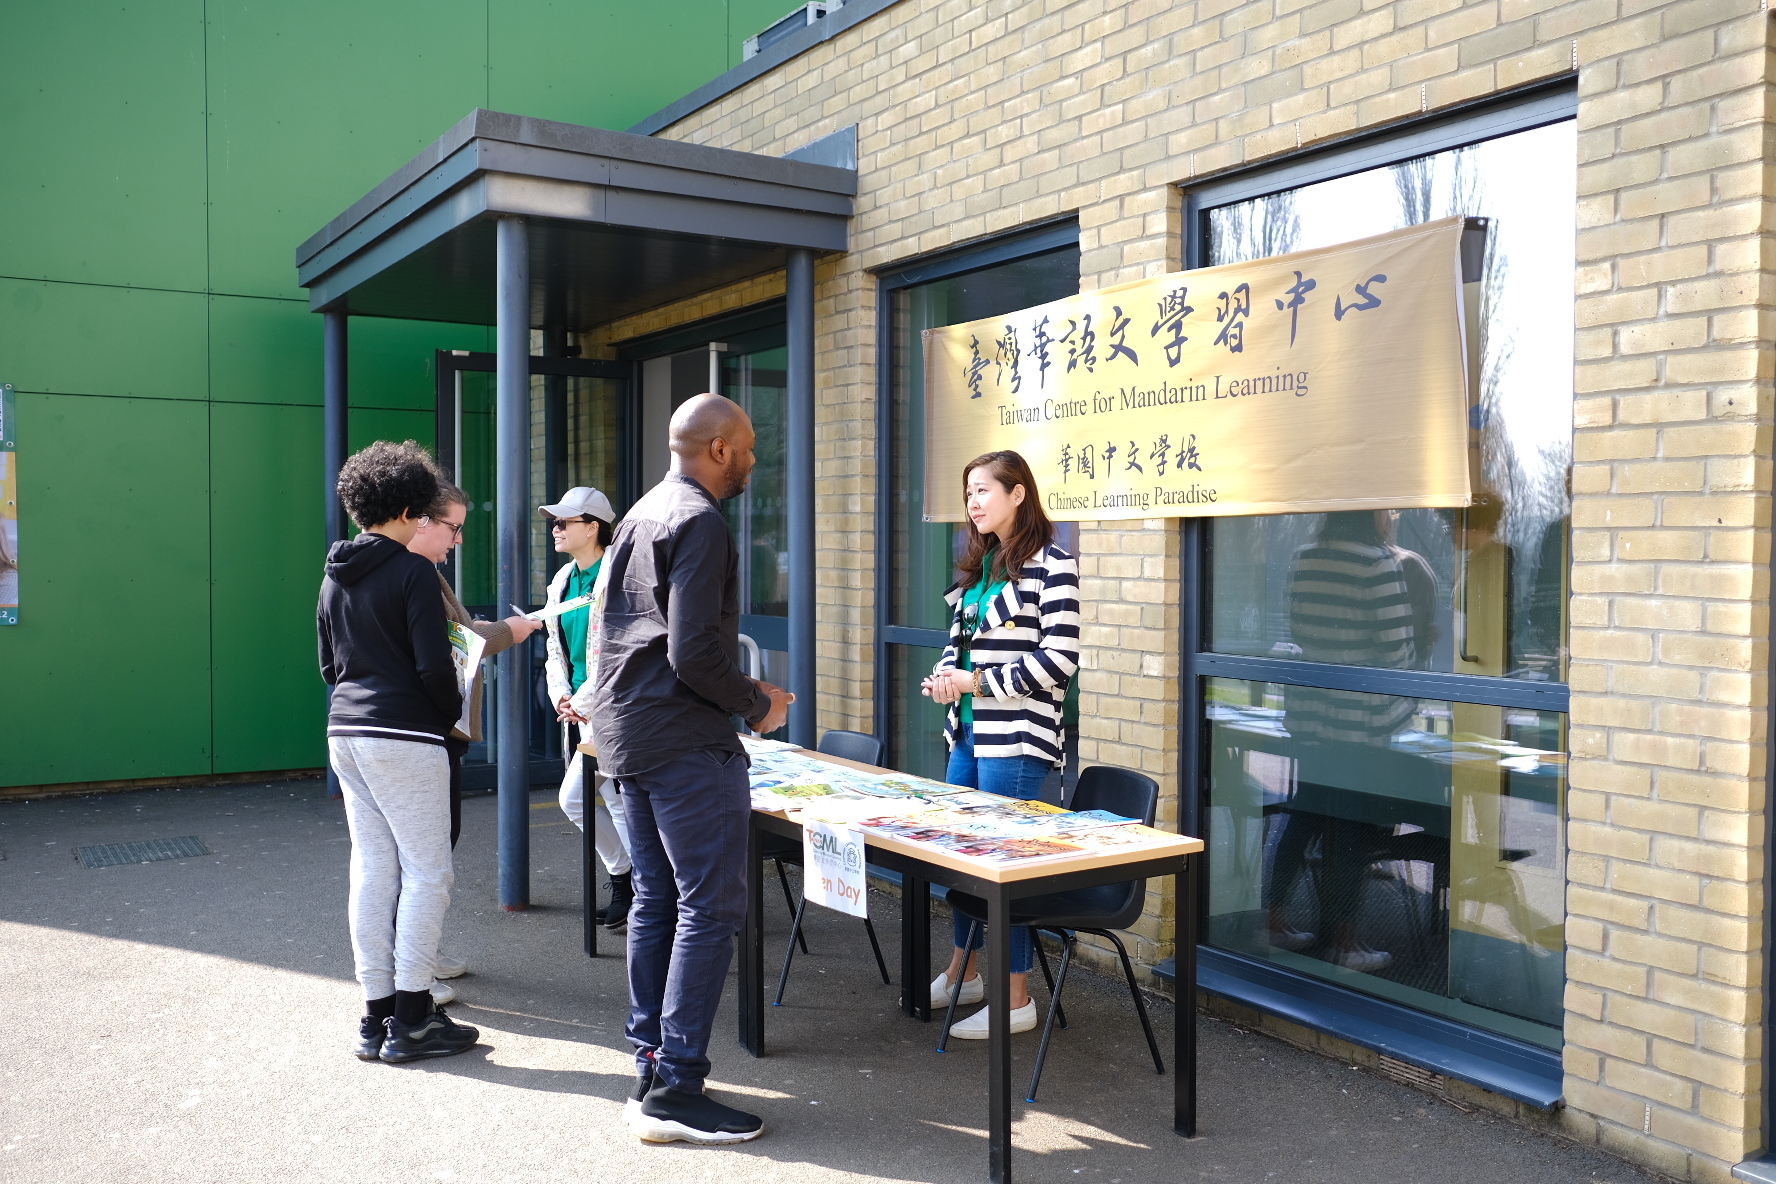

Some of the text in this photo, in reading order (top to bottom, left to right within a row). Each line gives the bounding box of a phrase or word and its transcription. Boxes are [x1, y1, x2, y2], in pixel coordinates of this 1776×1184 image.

[963, 270, 1388, 400] 臺灣華語文學習中心
[997, 366, 1309, 426] Taiwan Centre for Mandarin Learning
[1048, 484, 1218, 511] Chinese Learning Paradise
[837, 877, 861, 906] Day
